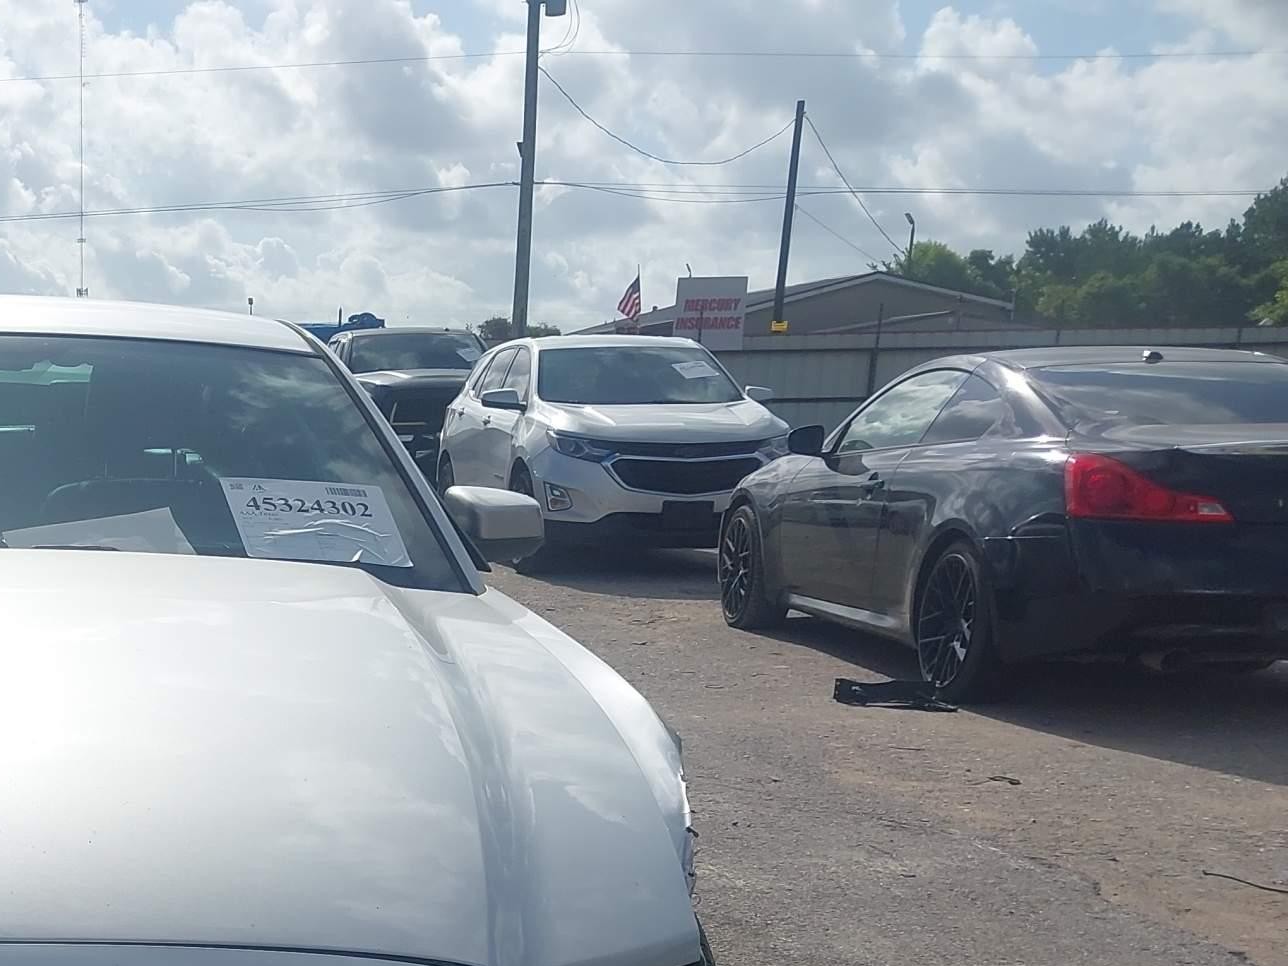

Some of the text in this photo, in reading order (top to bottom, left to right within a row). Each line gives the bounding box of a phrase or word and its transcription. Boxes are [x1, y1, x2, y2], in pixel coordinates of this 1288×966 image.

[683, 298, 741, 312] MERCURY
[675, 316, 742, 330] INSURANCE
[246, 496, 373, 518] 45324302
